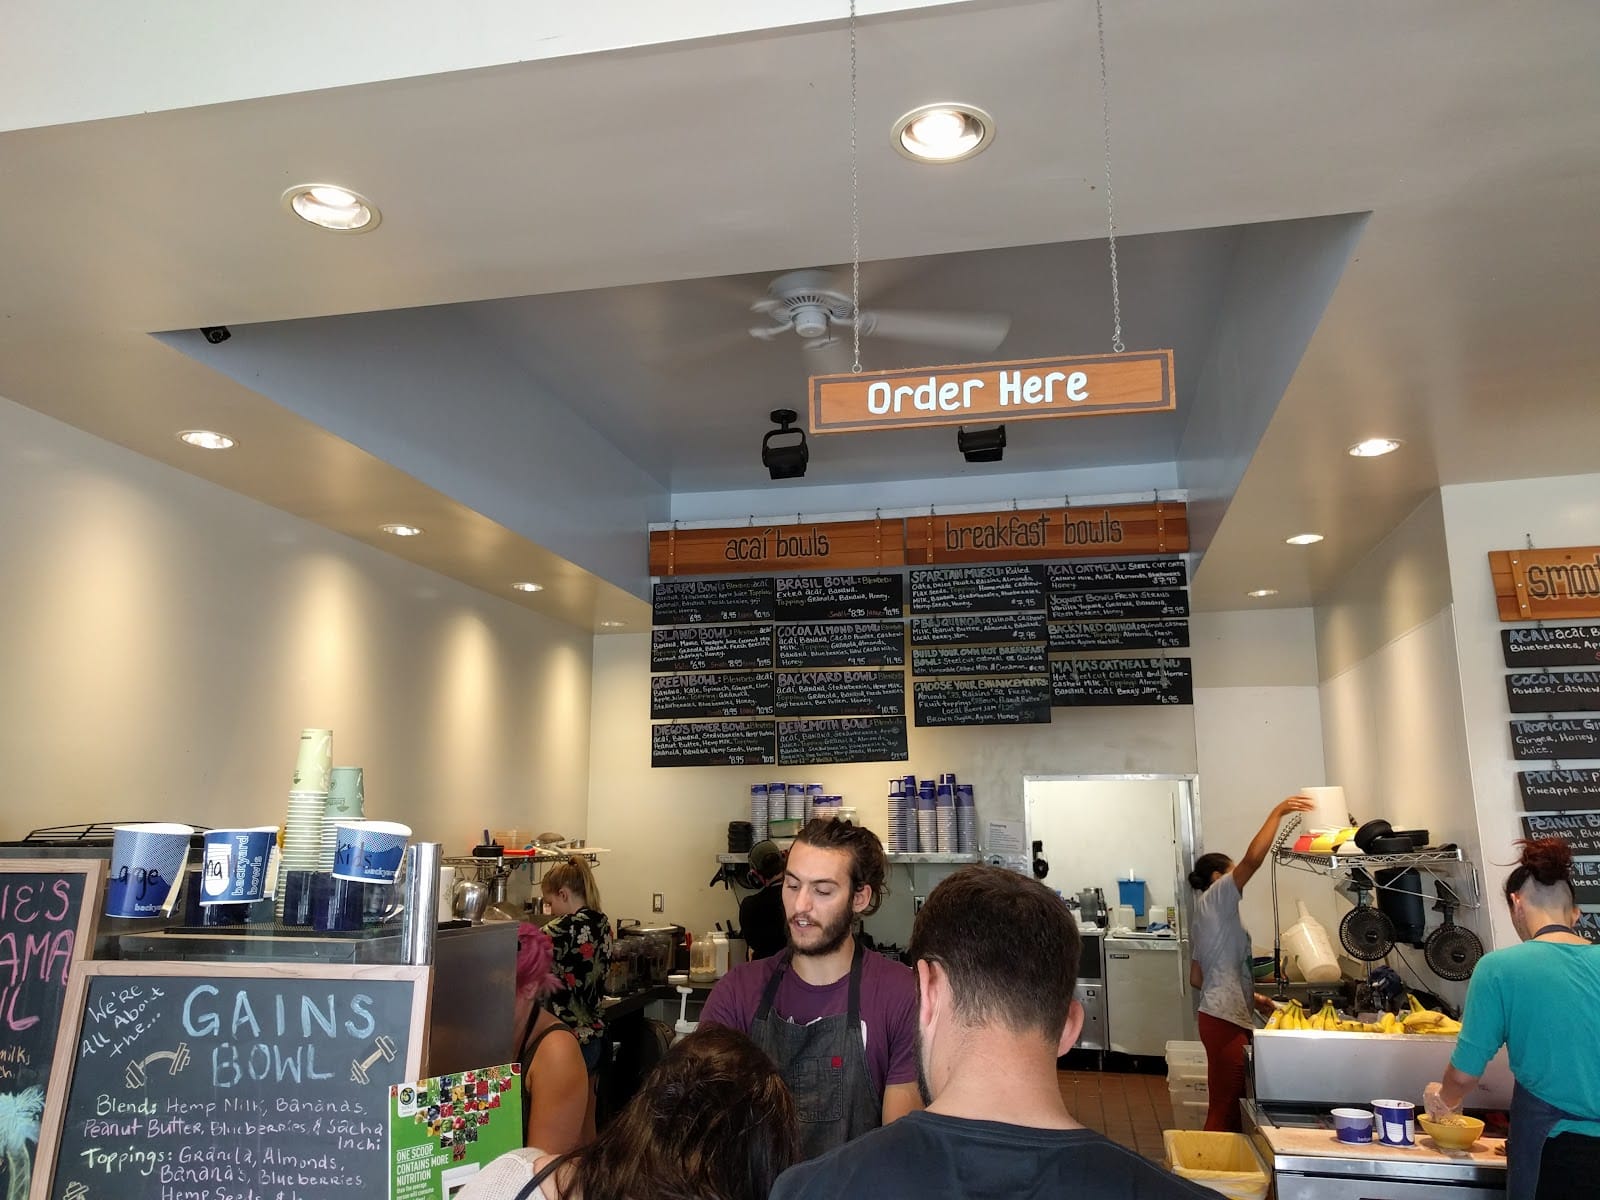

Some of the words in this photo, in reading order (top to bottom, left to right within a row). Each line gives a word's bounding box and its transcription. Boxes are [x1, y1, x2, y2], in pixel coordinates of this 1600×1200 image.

[868, 376, 984, 415] Order
[999, 370, 1089, 406] Here
[945, 512, 1050, 551] breakfast
[1064, 510, 1123, 545] bowls
[776, 528, 830, 558] bowls
[1075, 564, 1126, 573] OATMEAL:
[911, 570, 963, 583] SPARTAN
[655, 582, 695, 595] BERRY
[776, 578, 822, 591] BRASIL
[654, 629, 697, 642] ISLAND
[777, 626, 812, 637] COCOA
[813, 626, 853, 635] ALMOND
[1048, 623, 1103, 634] BACKYARD
[913, 650, 937, 658] BUILD
[960, 648, 980, 656] OWN
[1099, 659, 1148, 670] OATMEAL
[652, 677, 688, 689] GREEN
[778, 672, 842, 687] BACKYARD
[915, 681, 953, 691] CHOOSE
[954, 680, 977, 689] YOUR
[1511, 674, 1560, 686] COCOA
[692, 724, 721, 733] POWER
[779, 720, 839, 735] BEHEMOTH
[1512, 720, 1581, 734] TROPICAL
[1526, 786, 1578, 796] Pineapple
[1528, 816, 1586, 831] PEANUT
[232, 835, 249, 896] backyard
[247, 856, 262, 895] bowls
[183, 984, 376, 1039] GAINS
[212, 1042, 335, 1088] BOWL
[167, 1097, 216, 1117] Hemp
[83, 1120, 142, 1138] Peanut
[80, 1145, 172, 1176] Toppings:
[396, 1150, 411, 1161] ONE
[412, 1145, 433, 1159] SCOOP
[397, 1159, 430, 1175] CONTAINS
[431, 1154, 449, 1167] MORE
[396, 1169, 431, 1186] NUTRITION
